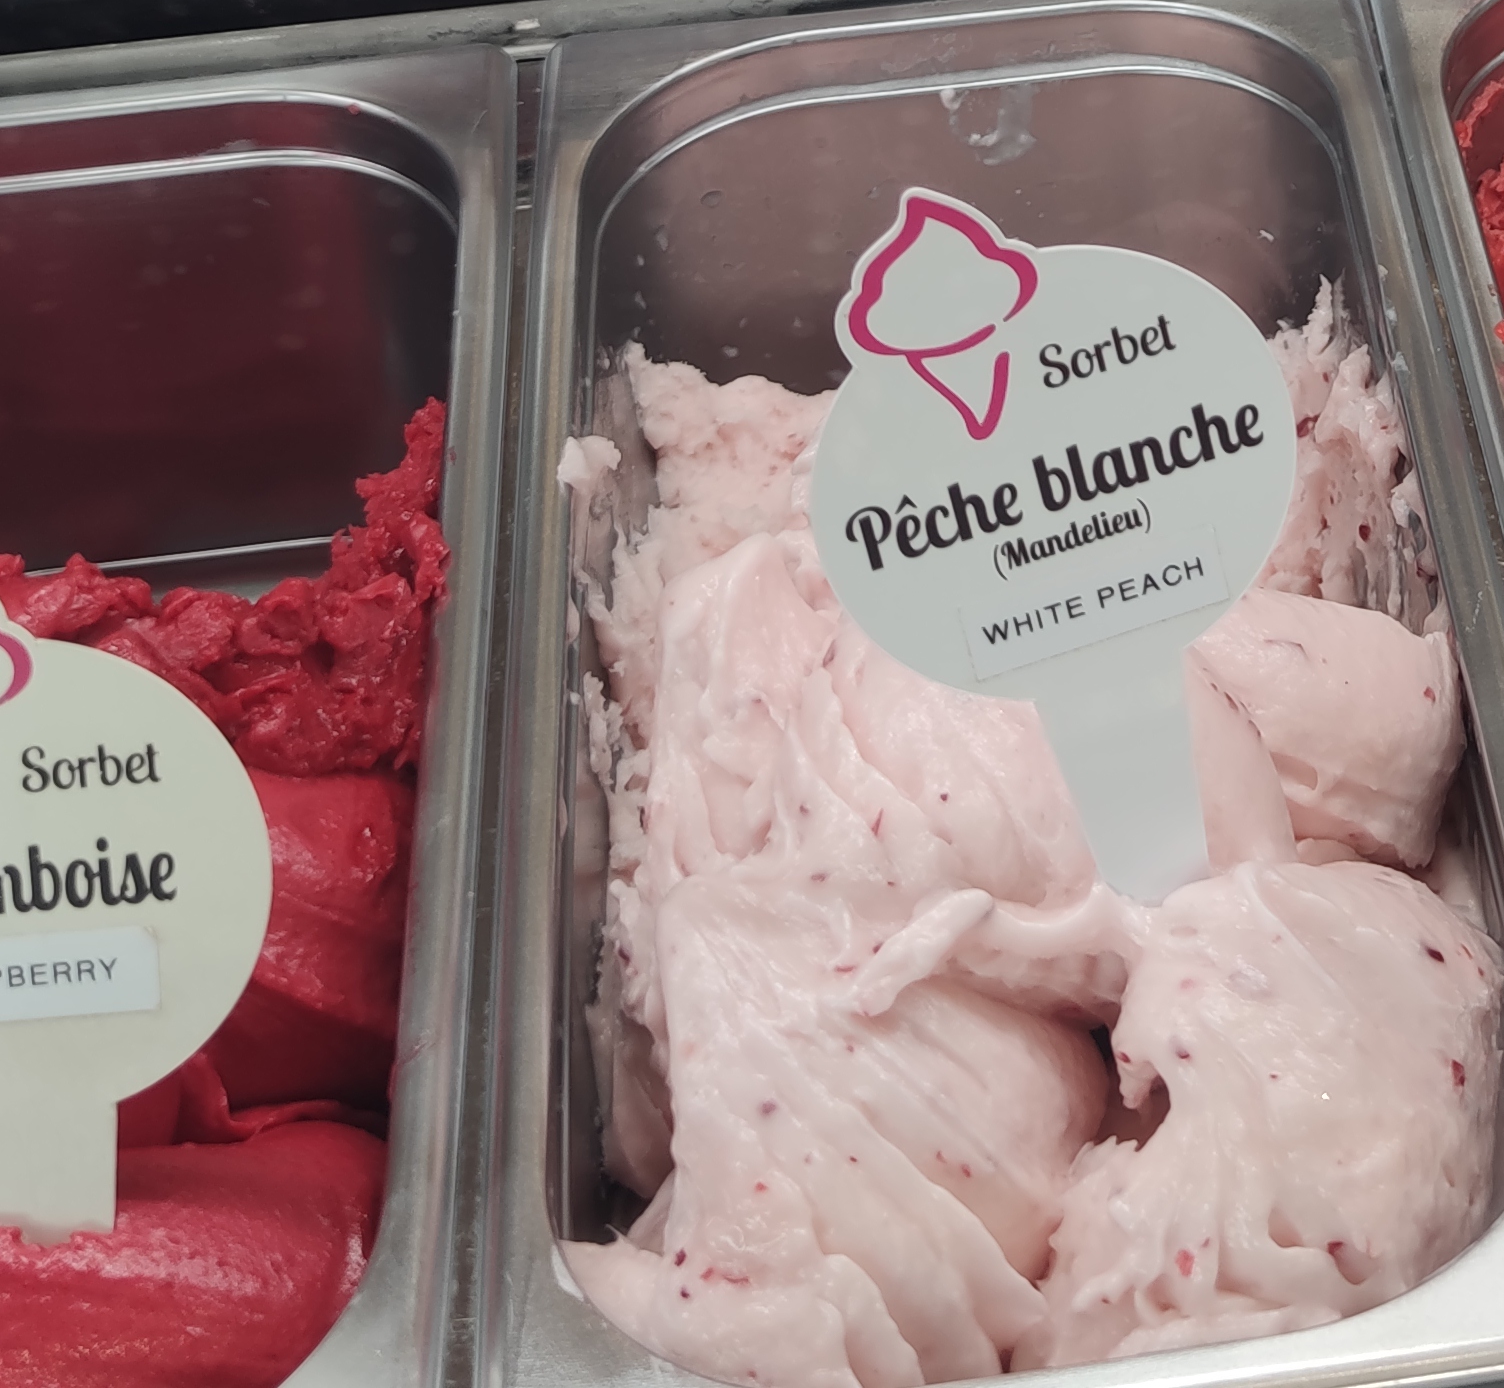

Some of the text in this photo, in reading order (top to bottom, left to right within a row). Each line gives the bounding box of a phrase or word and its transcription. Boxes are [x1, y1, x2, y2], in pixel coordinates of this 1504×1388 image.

[1039, 314, 1176, 388] Sorbet
[845, 402, 1264, 572] Pêche blanche
[992, 498, 1152, 581] (Mandelieu)
[982, 556, 1205, 645] WHITE PEACH
[20, 743, 161, 793] Sorbet
